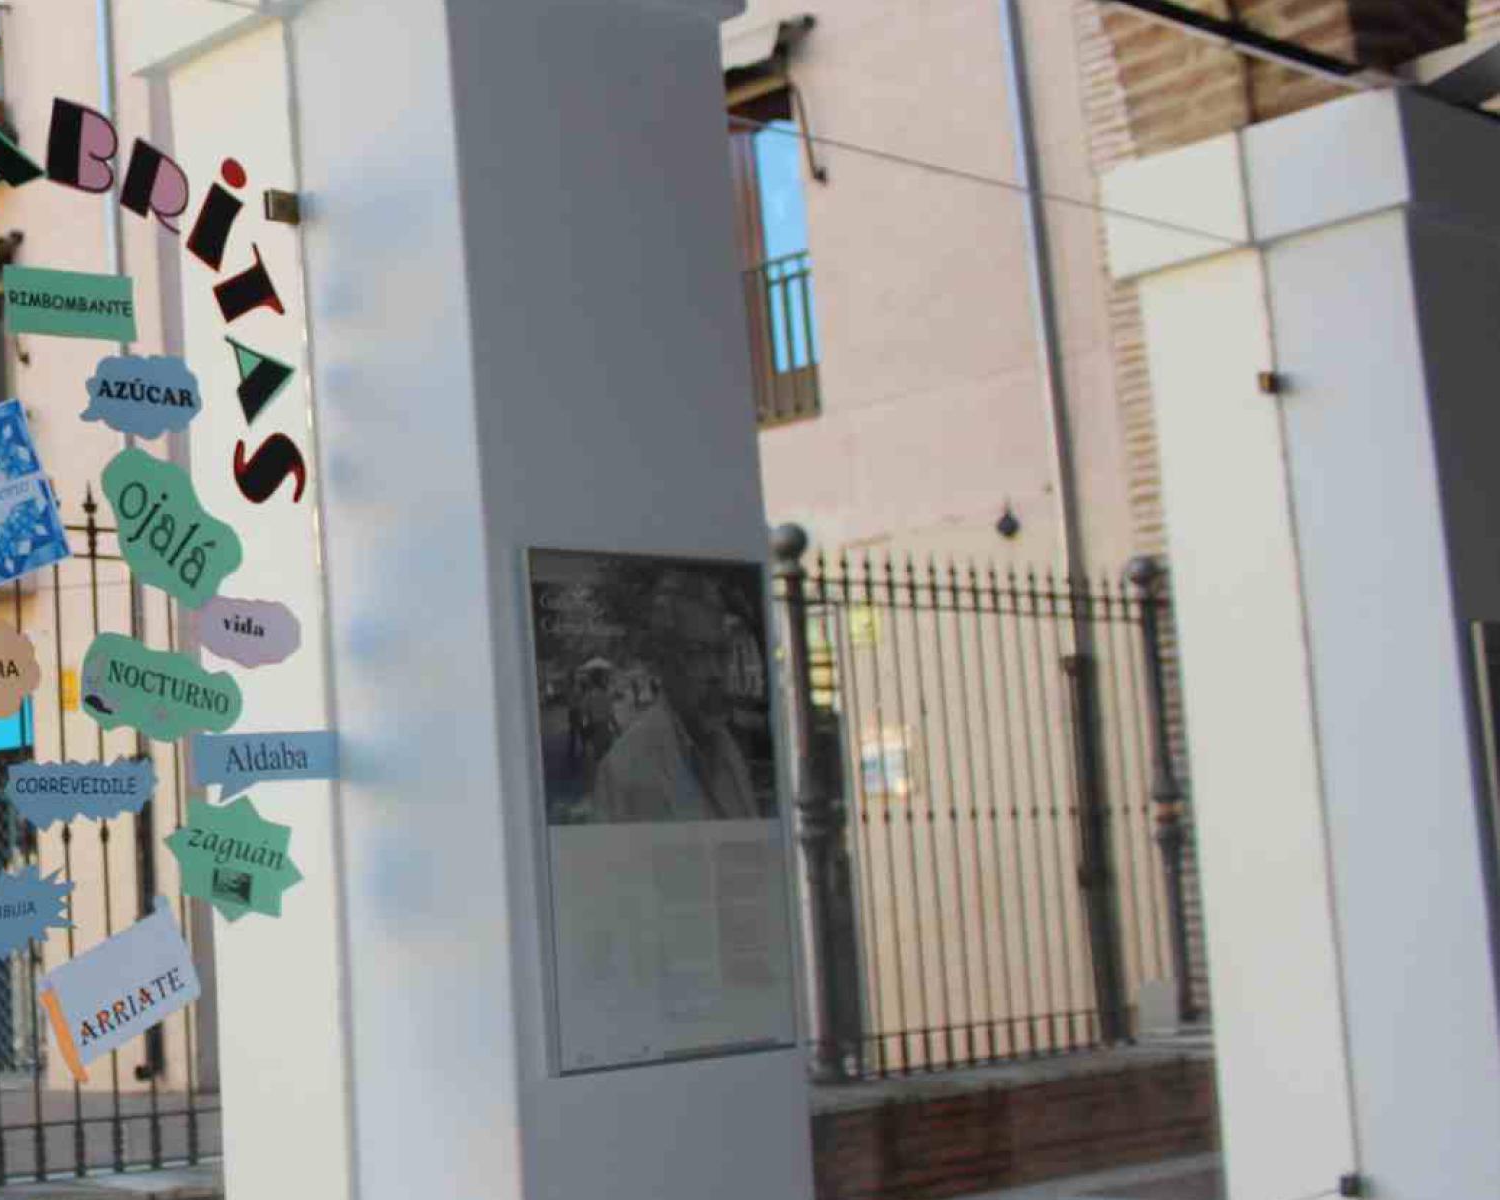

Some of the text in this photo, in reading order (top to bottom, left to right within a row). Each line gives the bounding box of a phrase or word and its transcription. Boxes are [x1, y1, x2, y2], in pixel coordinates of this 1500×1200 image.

[7, 289, 134, 318] RIMBOMBANTE
[99, 377, 196, 409] AZÚCAR
[119, 481, 217, 588] Ojalá
[223, 614, 266, 637] vida
[108, 659, 230, 715] NOCTURNO
[225, 741, 309, 773] Aldaba
[15, 776, 137, 796] CORREVEIDILE
[187, 828, 284, 871] zaguán
[81, 967, 185, 1045] ARRIATE
